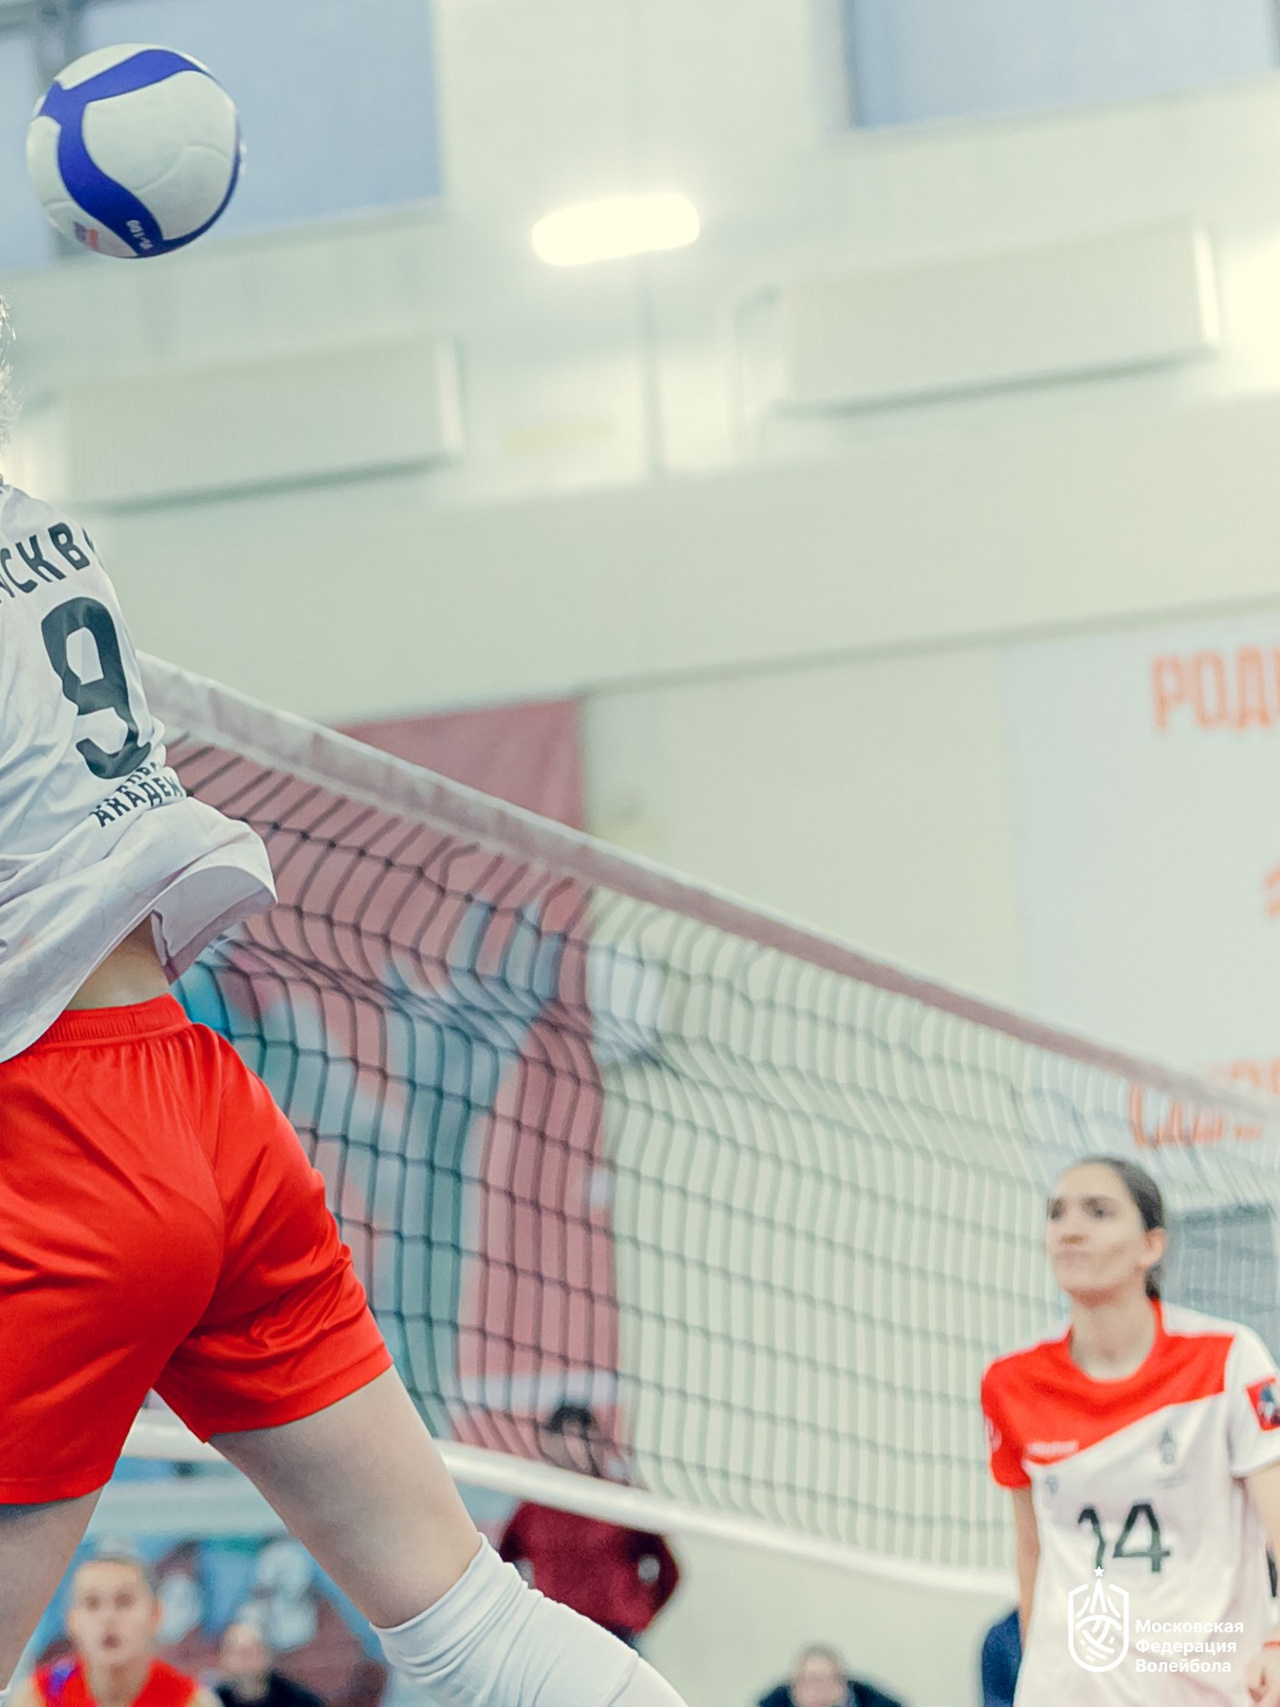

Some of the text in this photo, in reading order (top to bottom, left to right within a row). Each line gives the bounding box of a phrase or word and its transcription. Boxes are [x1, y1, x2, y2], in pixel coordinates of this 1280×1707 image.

[41, 596, 151, 780] 9
[1151, 645, 1280, 735] РОД
[1077, 1503, 1171, 1573] 14
